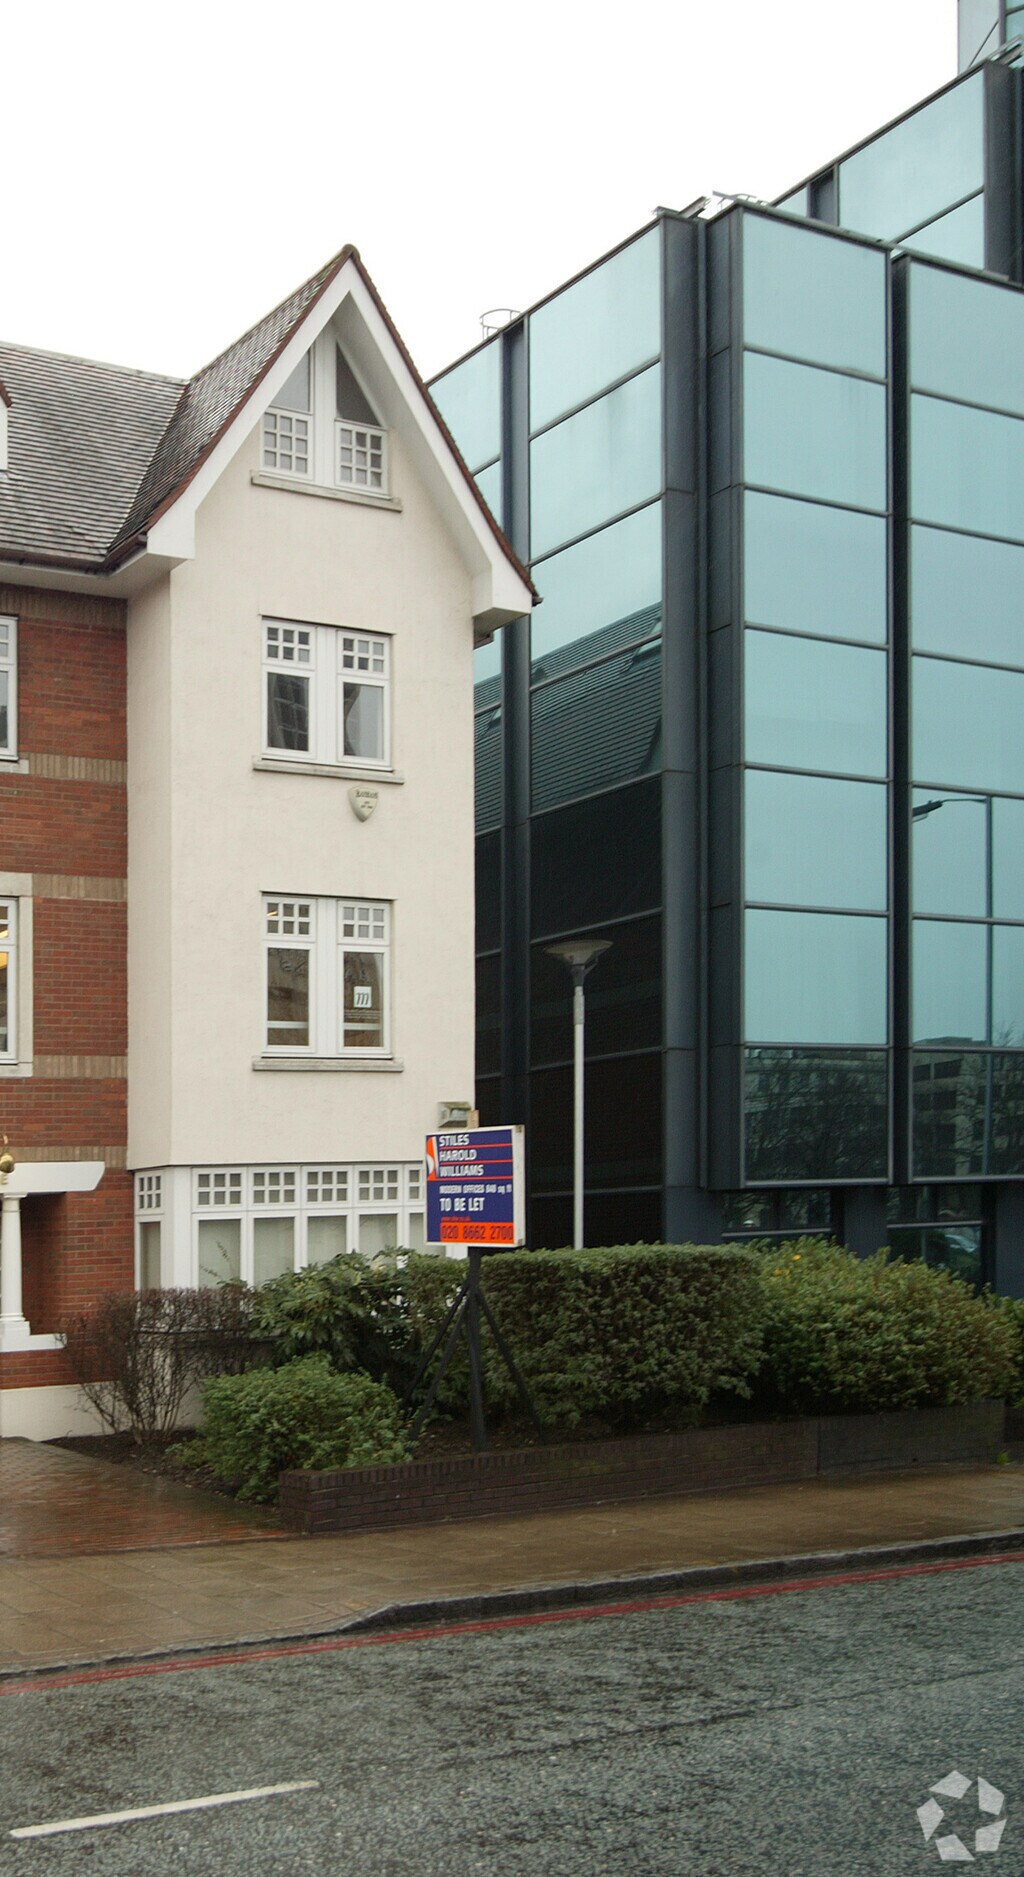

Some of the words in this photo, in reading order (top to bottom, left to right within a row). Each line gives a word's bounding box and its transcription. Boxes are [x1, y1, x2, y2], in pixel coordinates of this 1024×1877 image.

[439, 1134, 470, 1147] STILES
[439, 1149, 477, 1162] HAROLD
[439, 1164, 484, 1177] WILLIAMS
[463, 1184, 485, 1194] OFFICES
[439, 1197, 452, 1211] TO
[454, 1197, 466, 1211] BE
[468, 1197, 485, 1211] LET
[440, 1225, 459, 1239] 020
